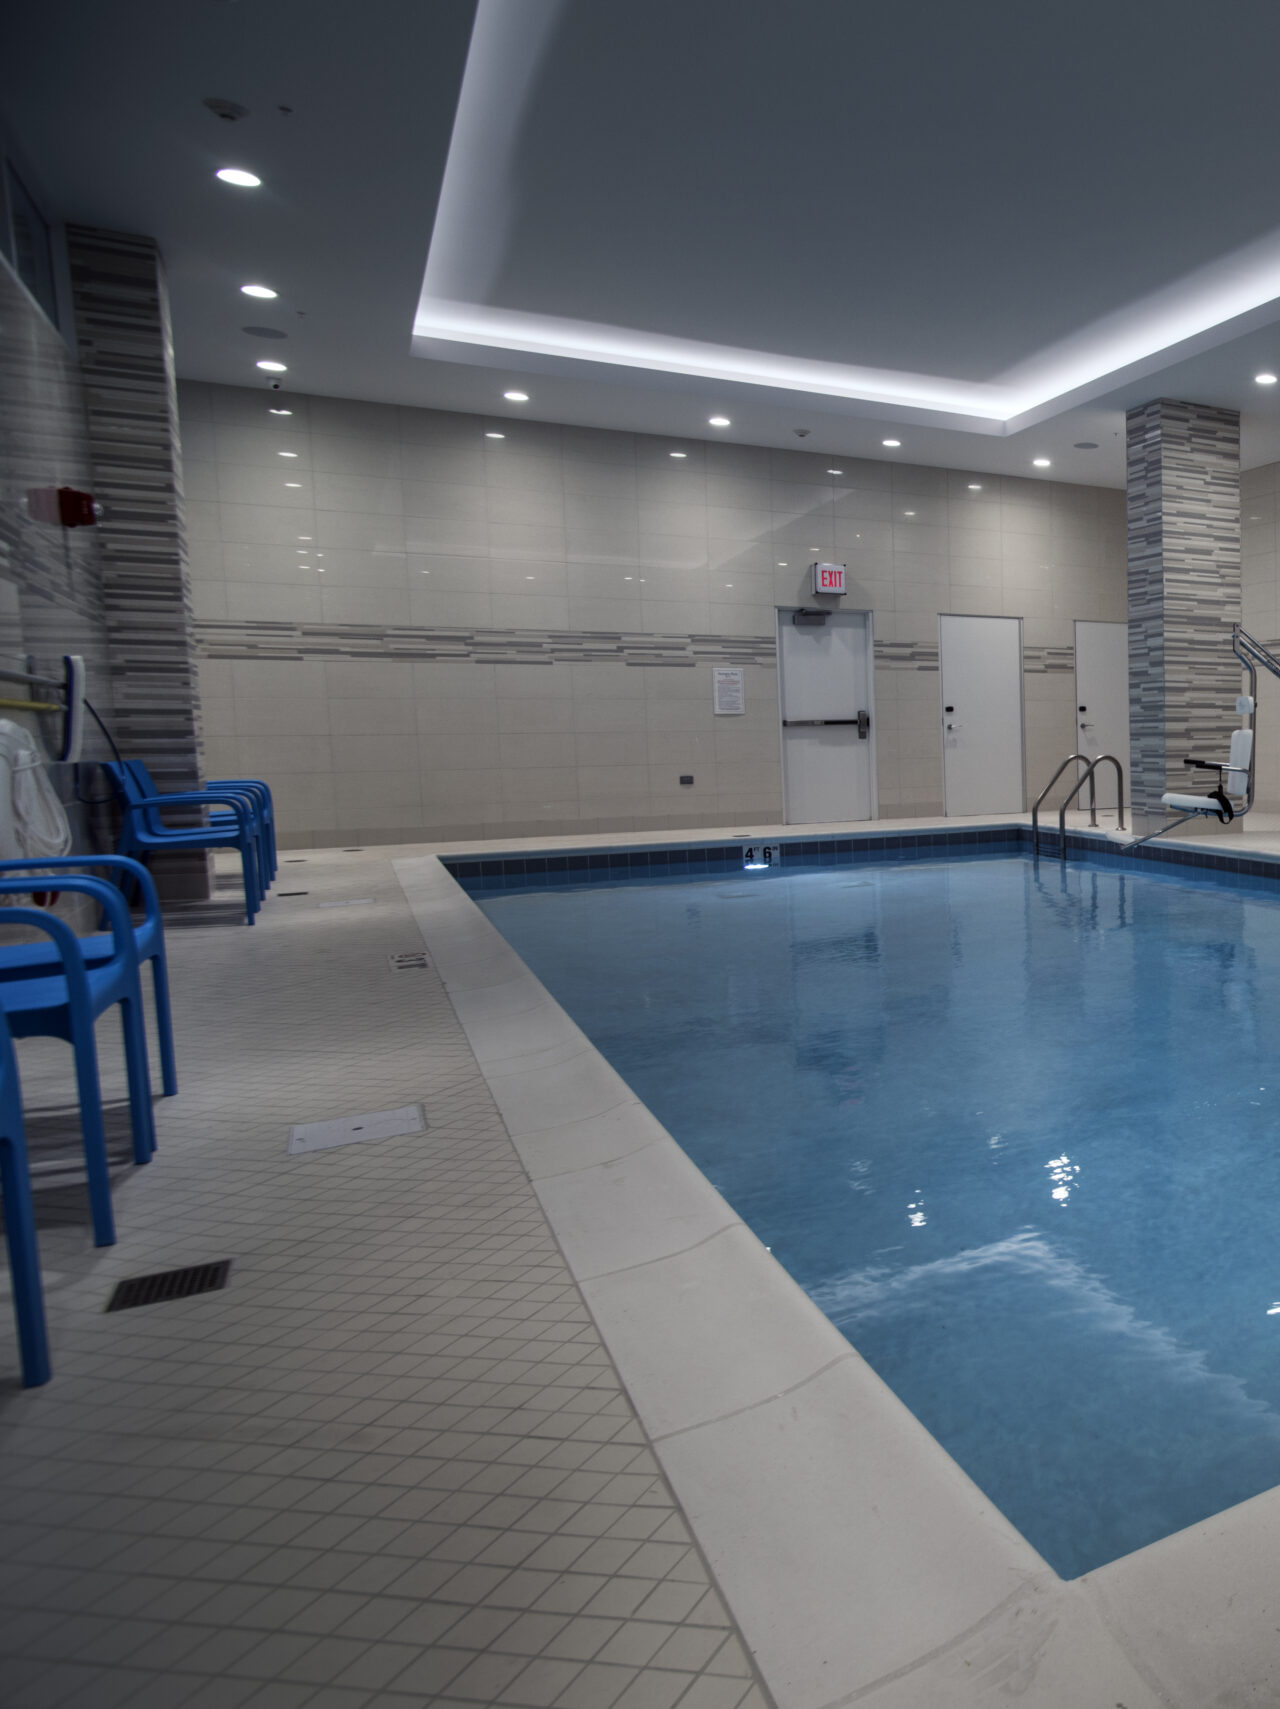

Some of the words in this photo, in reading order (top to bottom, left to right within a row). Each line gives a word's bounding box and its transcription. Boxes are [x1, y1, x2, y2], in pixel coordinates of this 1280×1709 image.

[821, 570, 843, 588] EXIT
[745, 848, 754, 859] 4
[763, 847, 772, 858] 6
